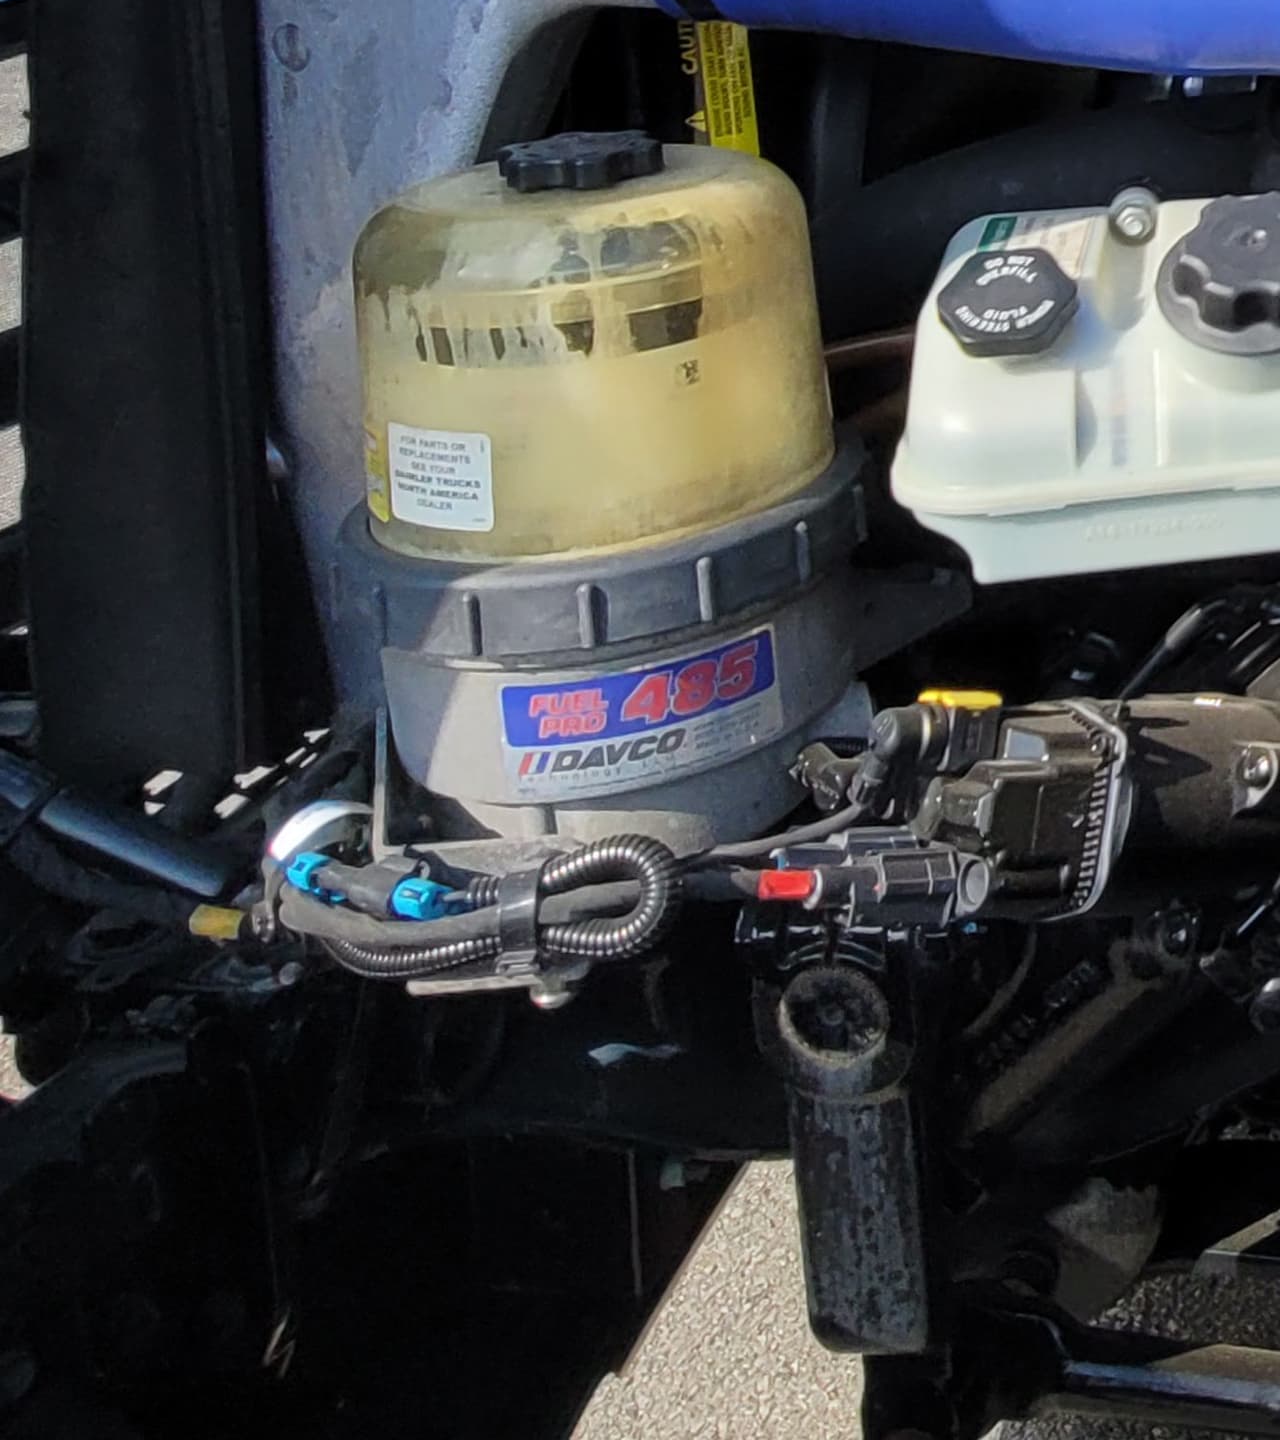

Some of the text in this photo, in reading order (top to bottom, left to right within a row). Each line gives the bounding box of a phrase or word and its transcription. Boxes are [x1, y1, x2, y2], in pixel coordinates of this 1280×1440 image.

[955, 305, 1011, 333] STEERING
[419, 438, 448, 450] PARTS
[451, 442, 467, 451] OR
[399, 447, 471, 465] REPLACEMENTS
[430, 464, 456, 475] YOUR
[436, 477, 482, 489] TRUCKS
[430, 488, 479, 502] AMERICA
[528, 687, 610, 718] FUEL
[620, 639, 759, 725] 485
[538, 710, 608, 739] PRO
[551, 727, 686, 773] DAVCO
